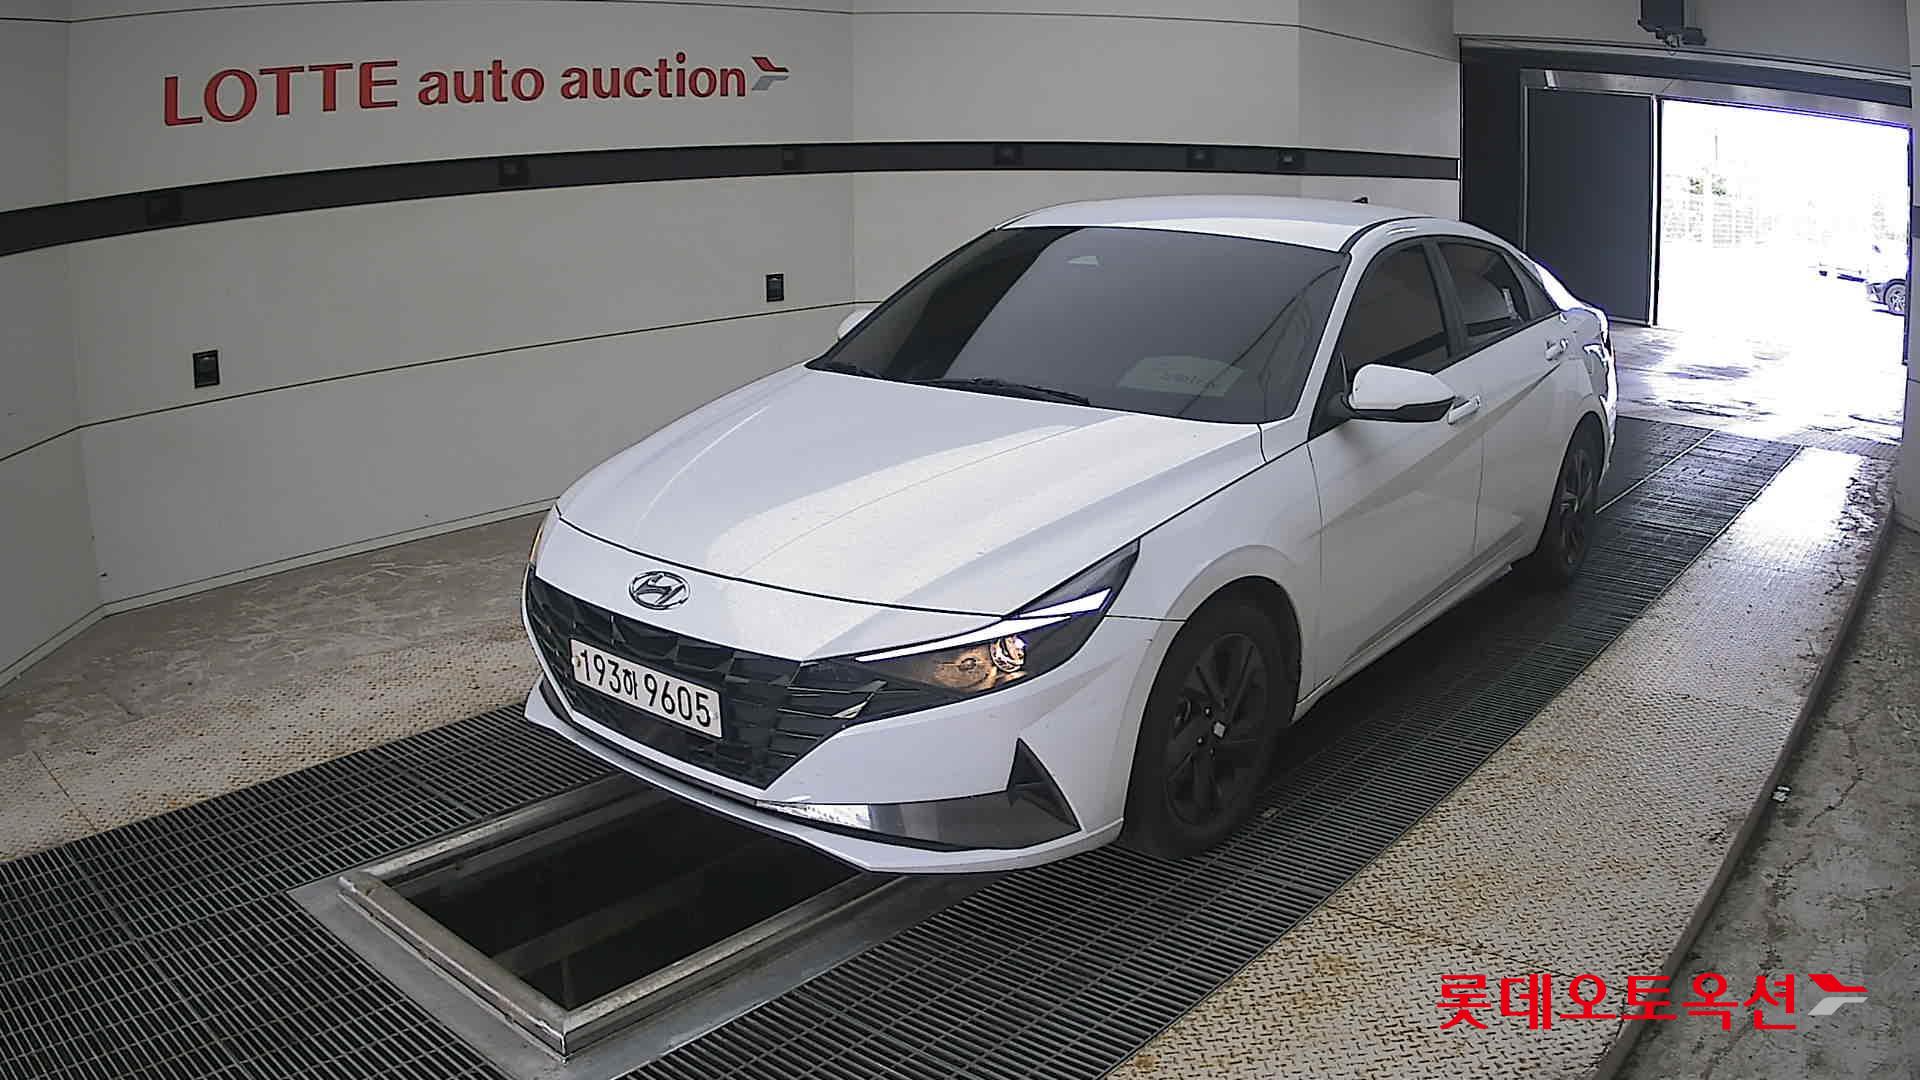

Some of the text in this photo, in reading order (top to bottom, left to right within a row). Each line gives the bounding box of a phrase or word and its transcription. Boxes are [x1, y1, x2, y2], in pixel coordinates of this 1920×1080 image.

[164, 51, 748, 127] LOTTE auto auction
[579, 649, 711, 728] 193하 9605
